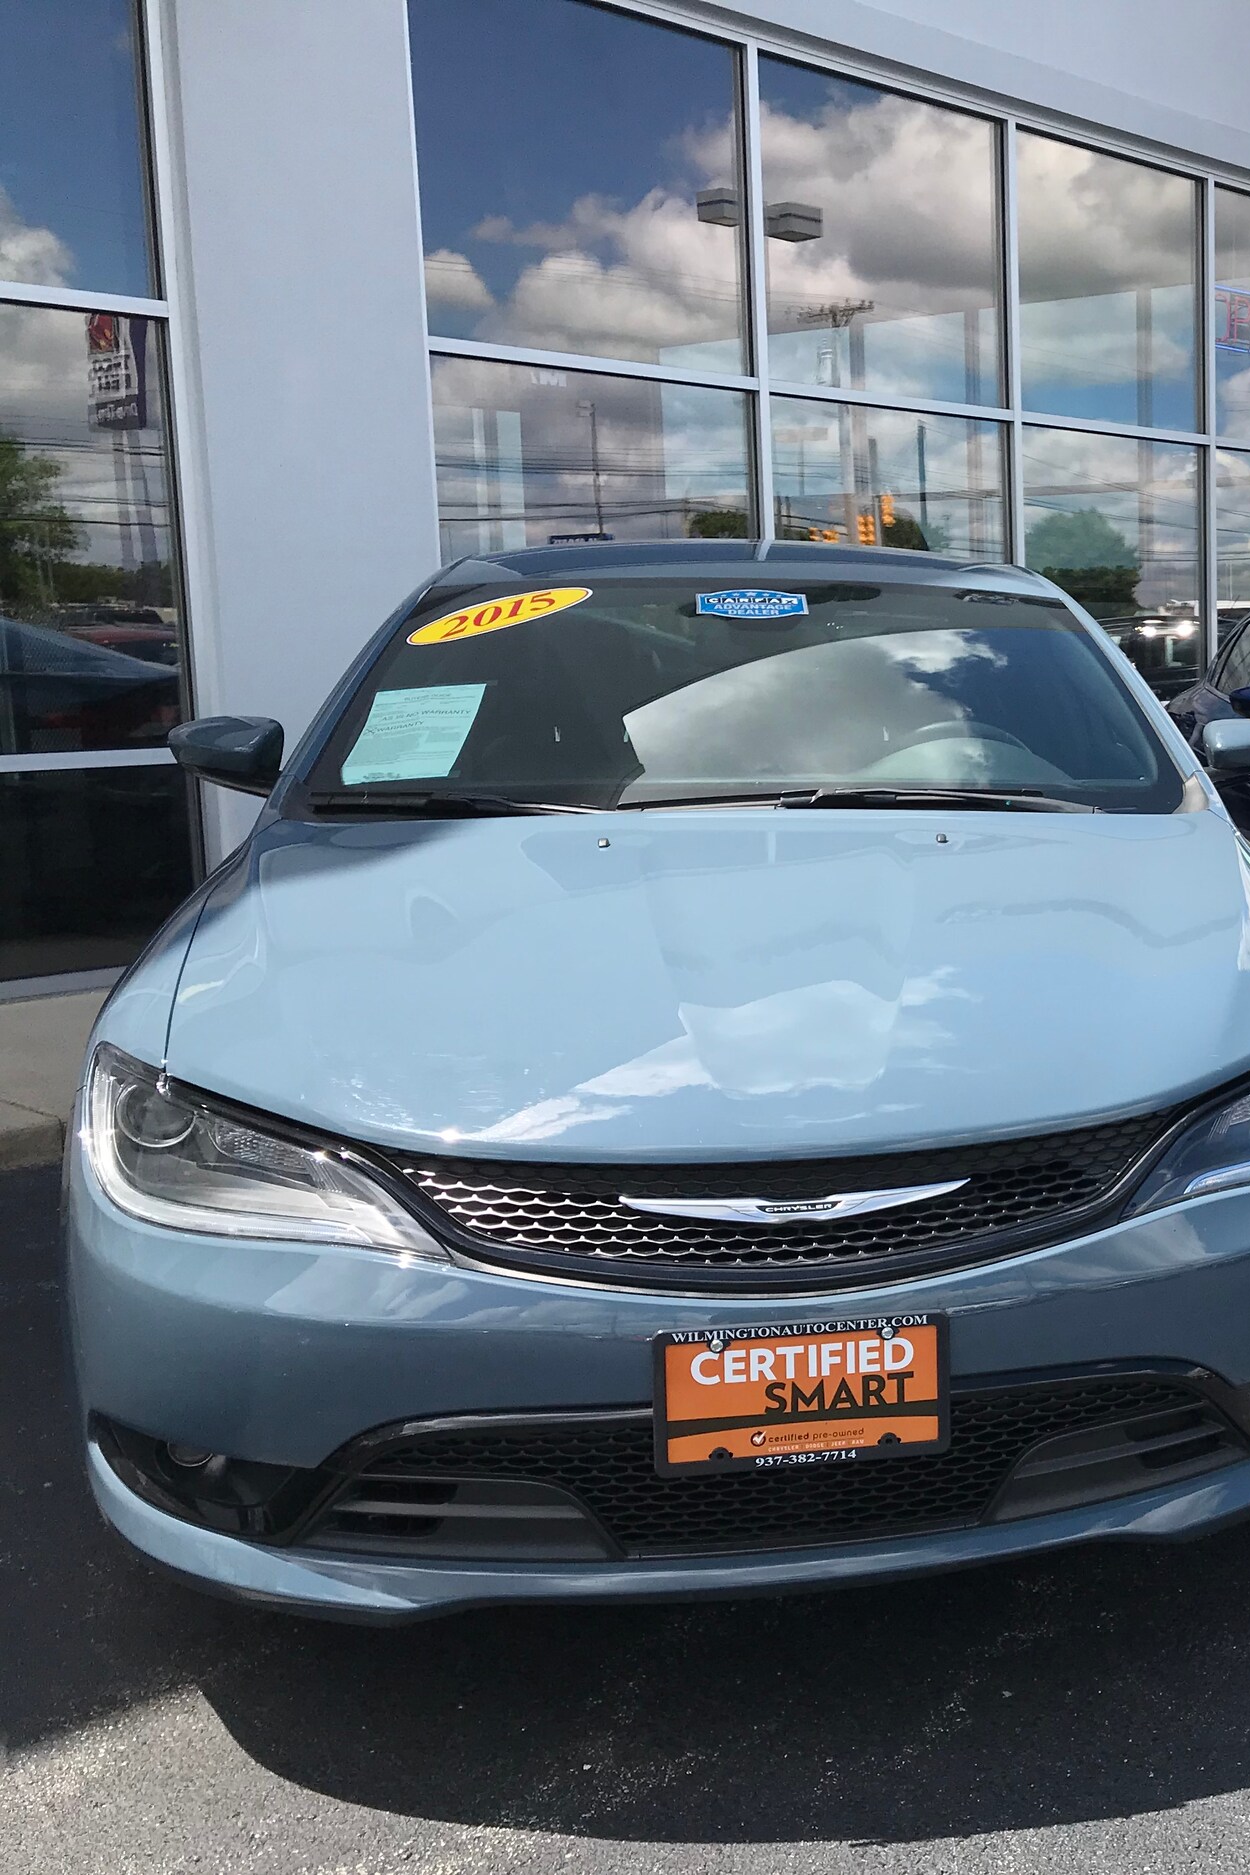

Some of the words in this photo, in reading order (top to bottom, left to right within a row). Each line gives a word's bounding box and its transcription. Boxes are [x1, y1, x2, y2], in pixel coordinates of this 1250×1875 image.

[440, 592, 555, 639] 2015
[765, 1203, 832, 1212] CHRYSLER
[672, 1314, 928, 1343] WILMINGTONAUTOCENTER.COM
[690, 1337, 914, 1385] CERTIFIED
[764, 1371, 914, 1414] SMART
[768, 1433, 809, 1442] certified
[812, 1428, 864, 1441] pre-owned
[755, 1449, 857, 1467] 937-382-7714
